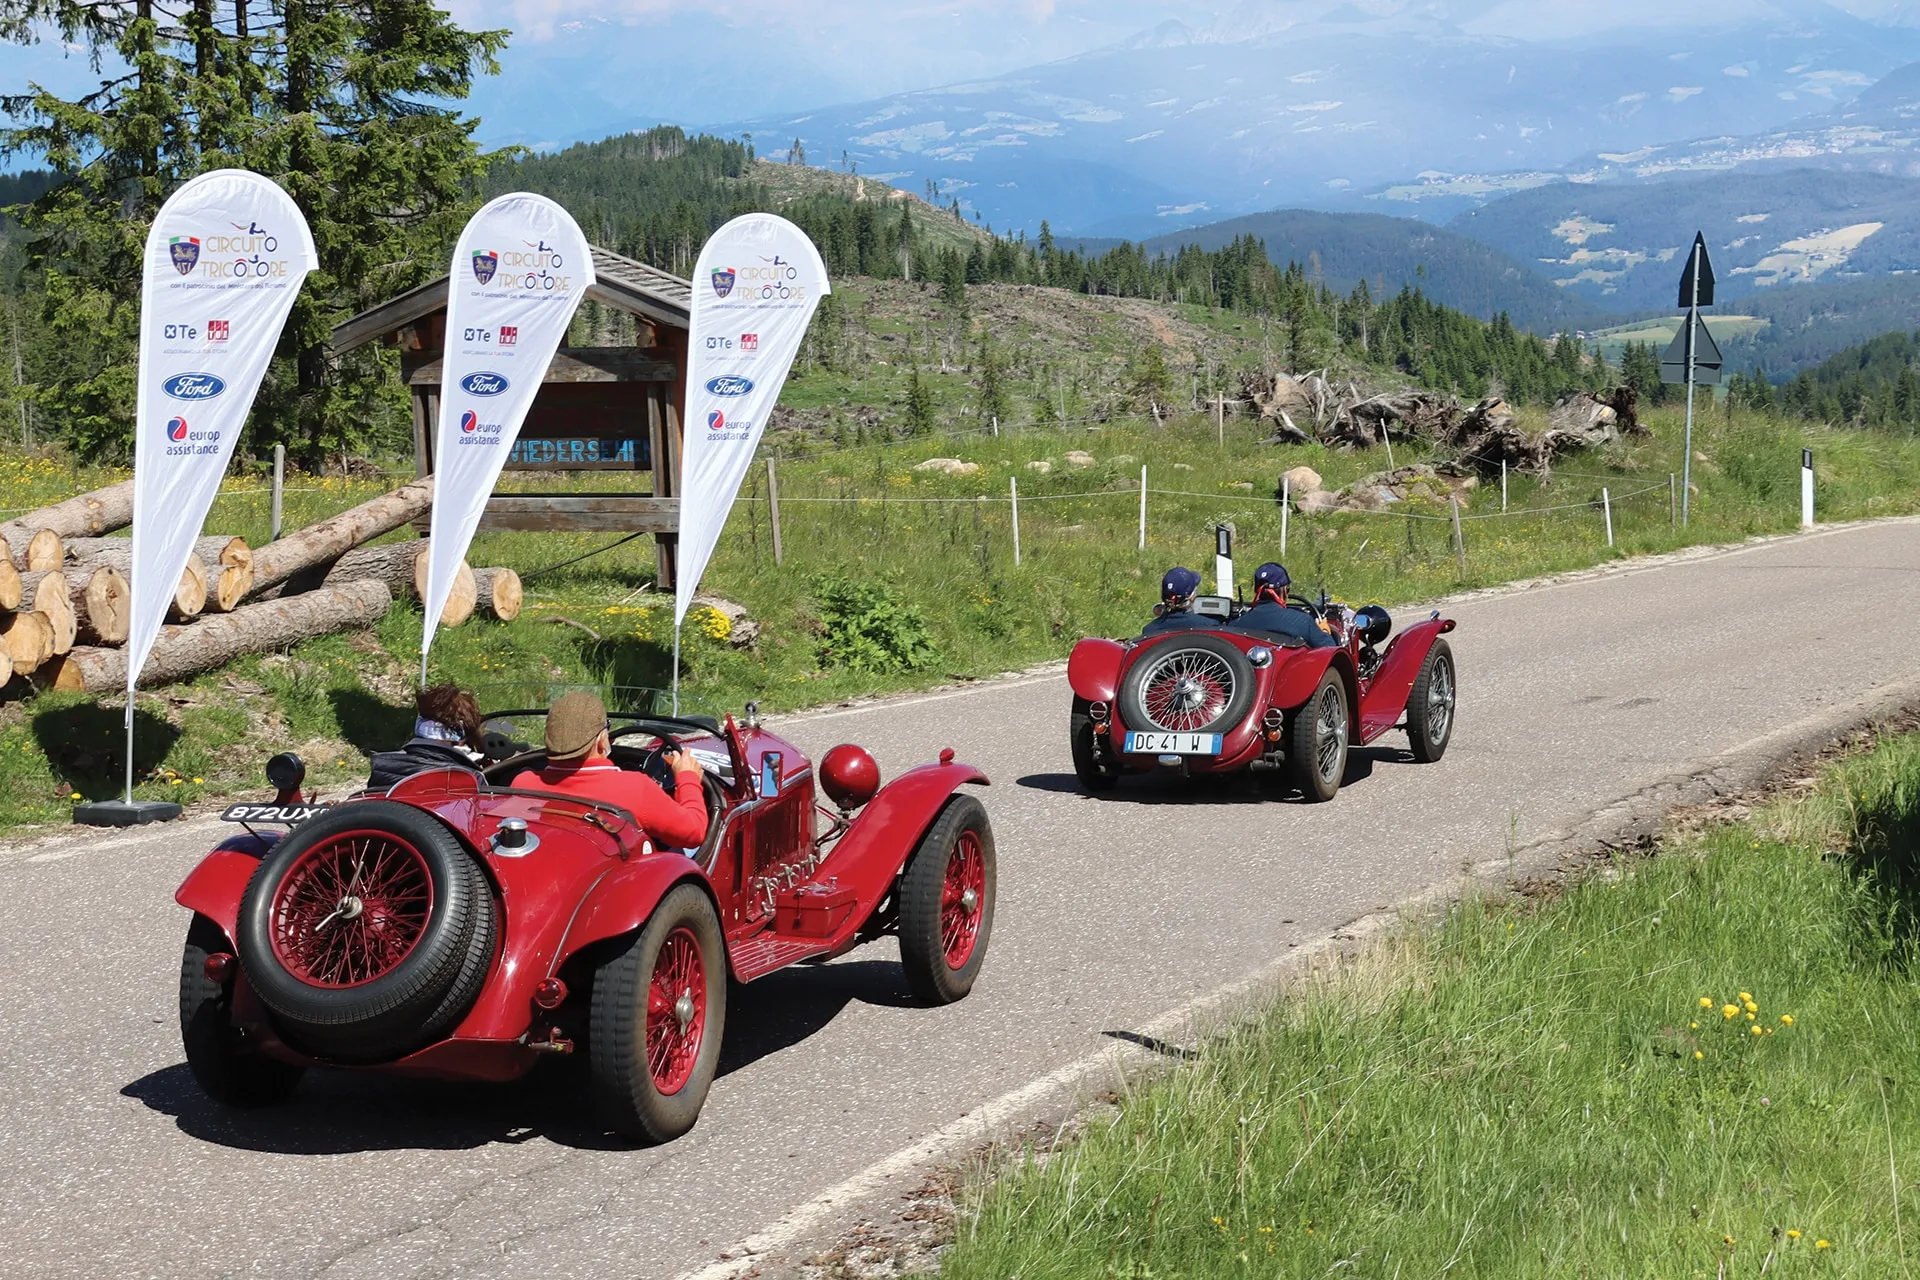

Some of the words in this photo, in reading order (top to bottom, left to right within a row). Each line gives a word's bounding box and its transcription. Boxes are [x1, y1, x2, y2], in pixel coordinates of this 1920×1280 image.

[206, 236, 278, 252] CIRCUITO
[503, 251, 562, 268] CIRCUITO
[200, 260, 288, 278] TRICOLORE
[740, 267, 797, 280] CIRCUITO
[497, 273, 571, 291] TRICOLORE
[736, 286, 806, 300] TRICOLORE
[174, 376, 214, 396] Ford
[469, 375, 500, 392] Ford
[714, 378, 745, 393] Ford
[477, 423, 502, 435] europ
[725, 421, 751, 431] europ
[189, 431, 220, 442] europ
[459, 434, 500, 445] assistance
[707, 431, 749, 440] assistance
[166, 443, 219, 455] assistance
[1135, 734, 1155, 750] DC
[1161, 735, 1178, 751] 41
[1191, 735, 1201, 751] W
[228, 806, 330, 820] 872UX
